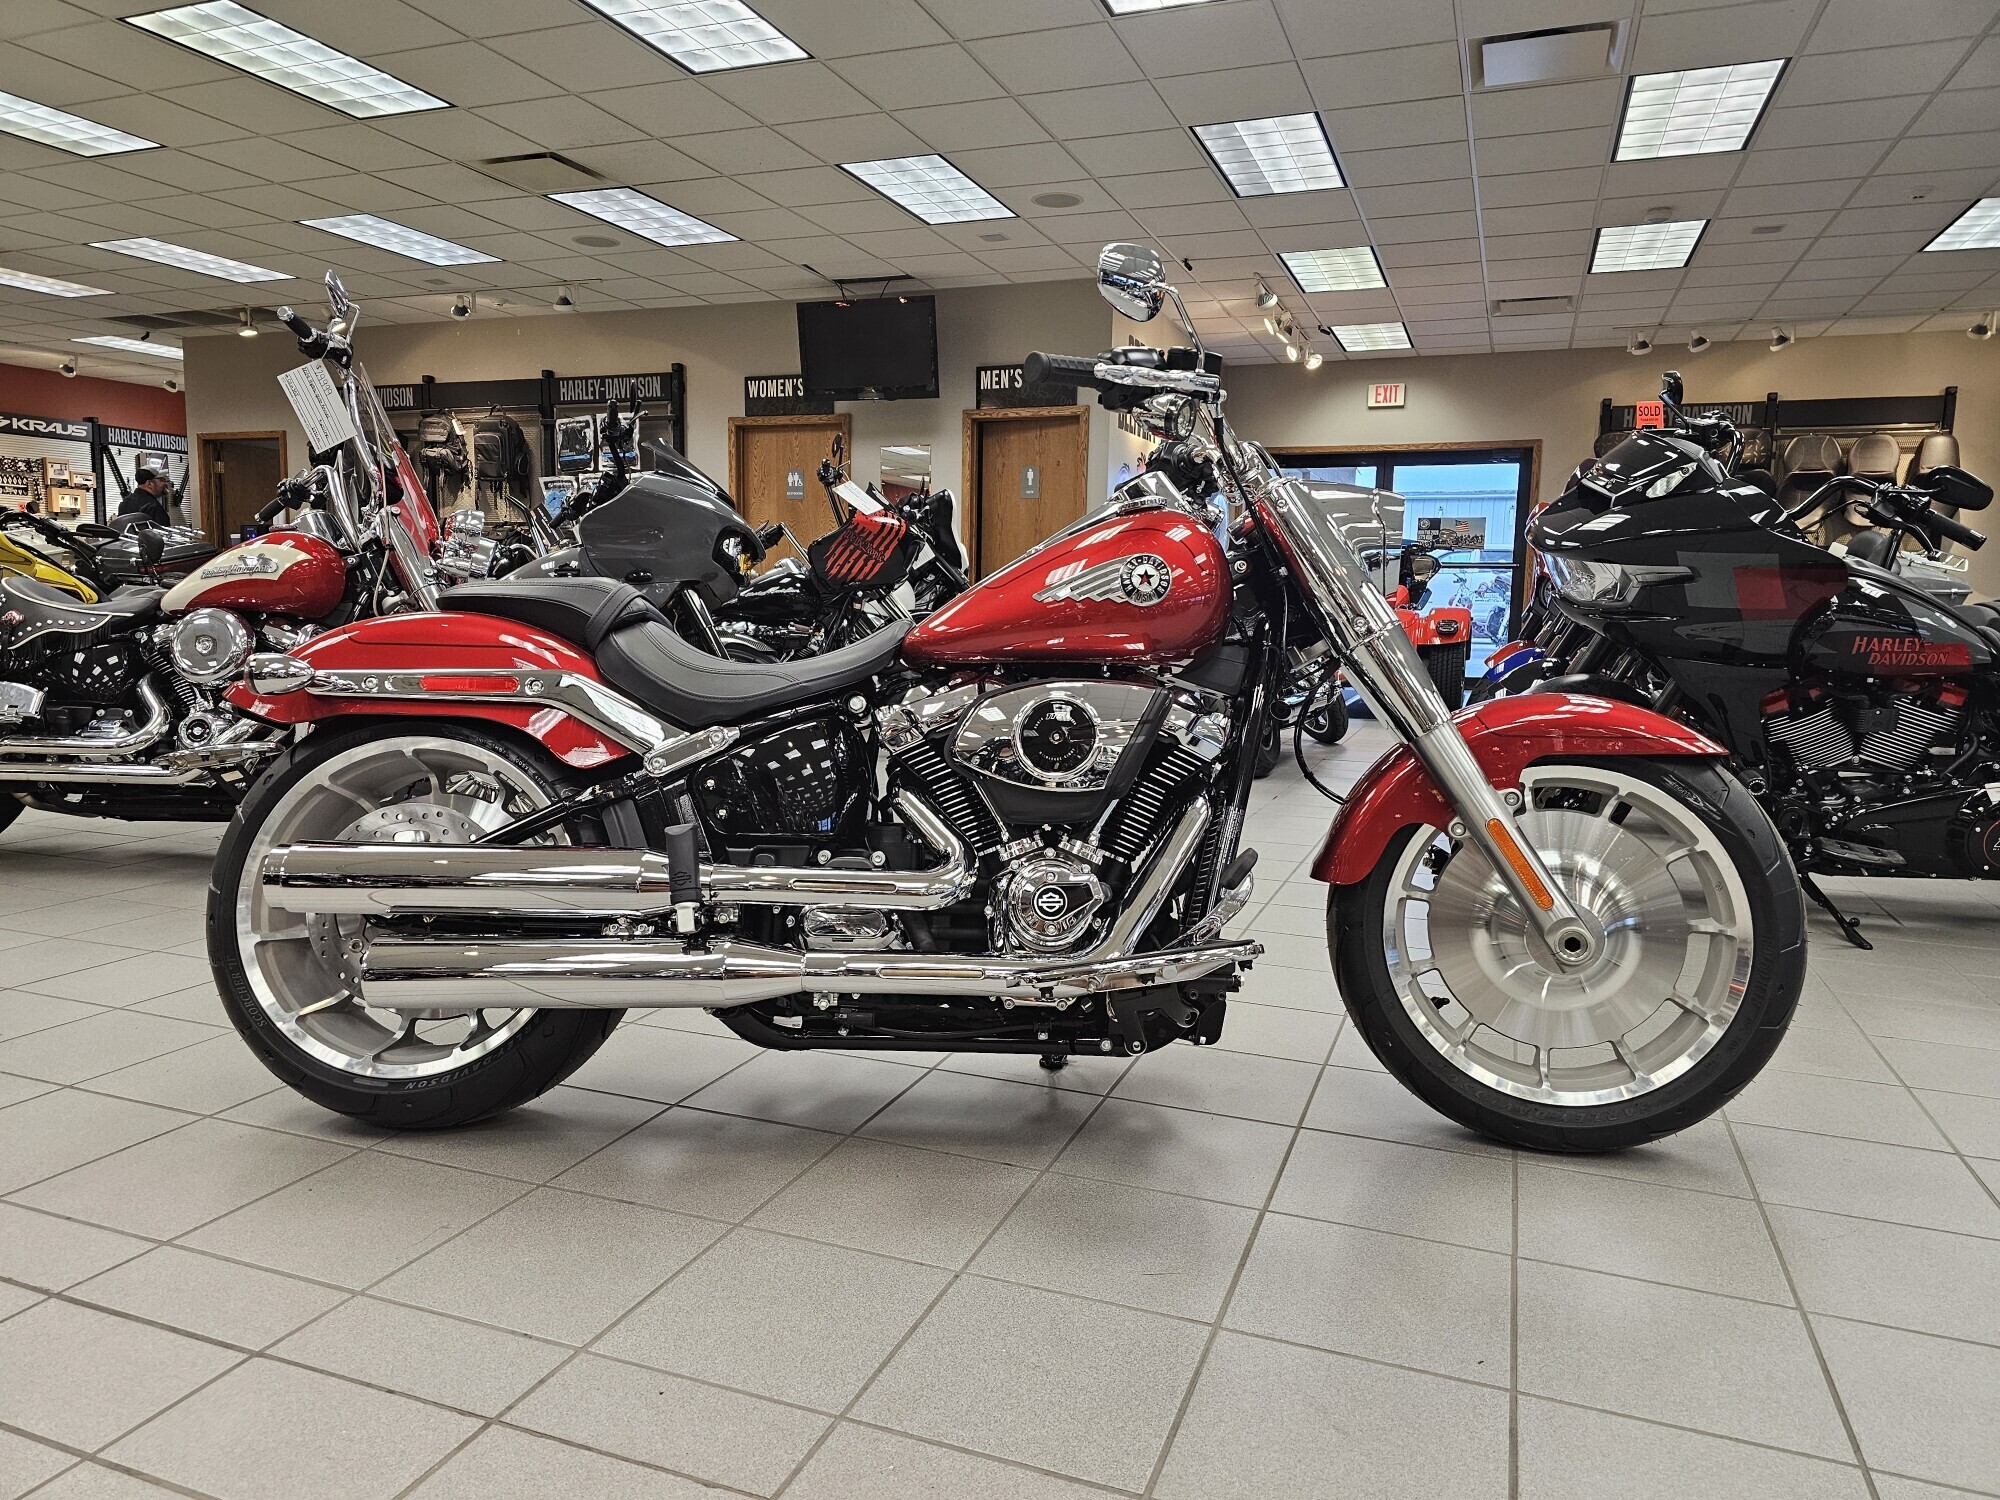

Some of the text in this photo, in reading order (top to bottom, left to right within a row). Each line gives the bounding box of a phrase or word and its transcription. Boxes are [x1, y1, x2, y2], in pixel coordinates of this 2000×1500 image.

[748, 378, 804, 399] WOMEN'S
[980, 368, 1023, 391] MEN'S
[1375, 384, 1399, 403] EXIT
[1638, 405, 1661, 417] SOLD
[12, 417, 88, 437] KRAUS
[107, 427, 188, 452] HARLEY-DAVIDSON
[1851, 635, 1934, 655] HARLEY-
[1867, 652, 1950, 666] DAVIDSON
[231, 972, 268, 1027] SCORCHER
